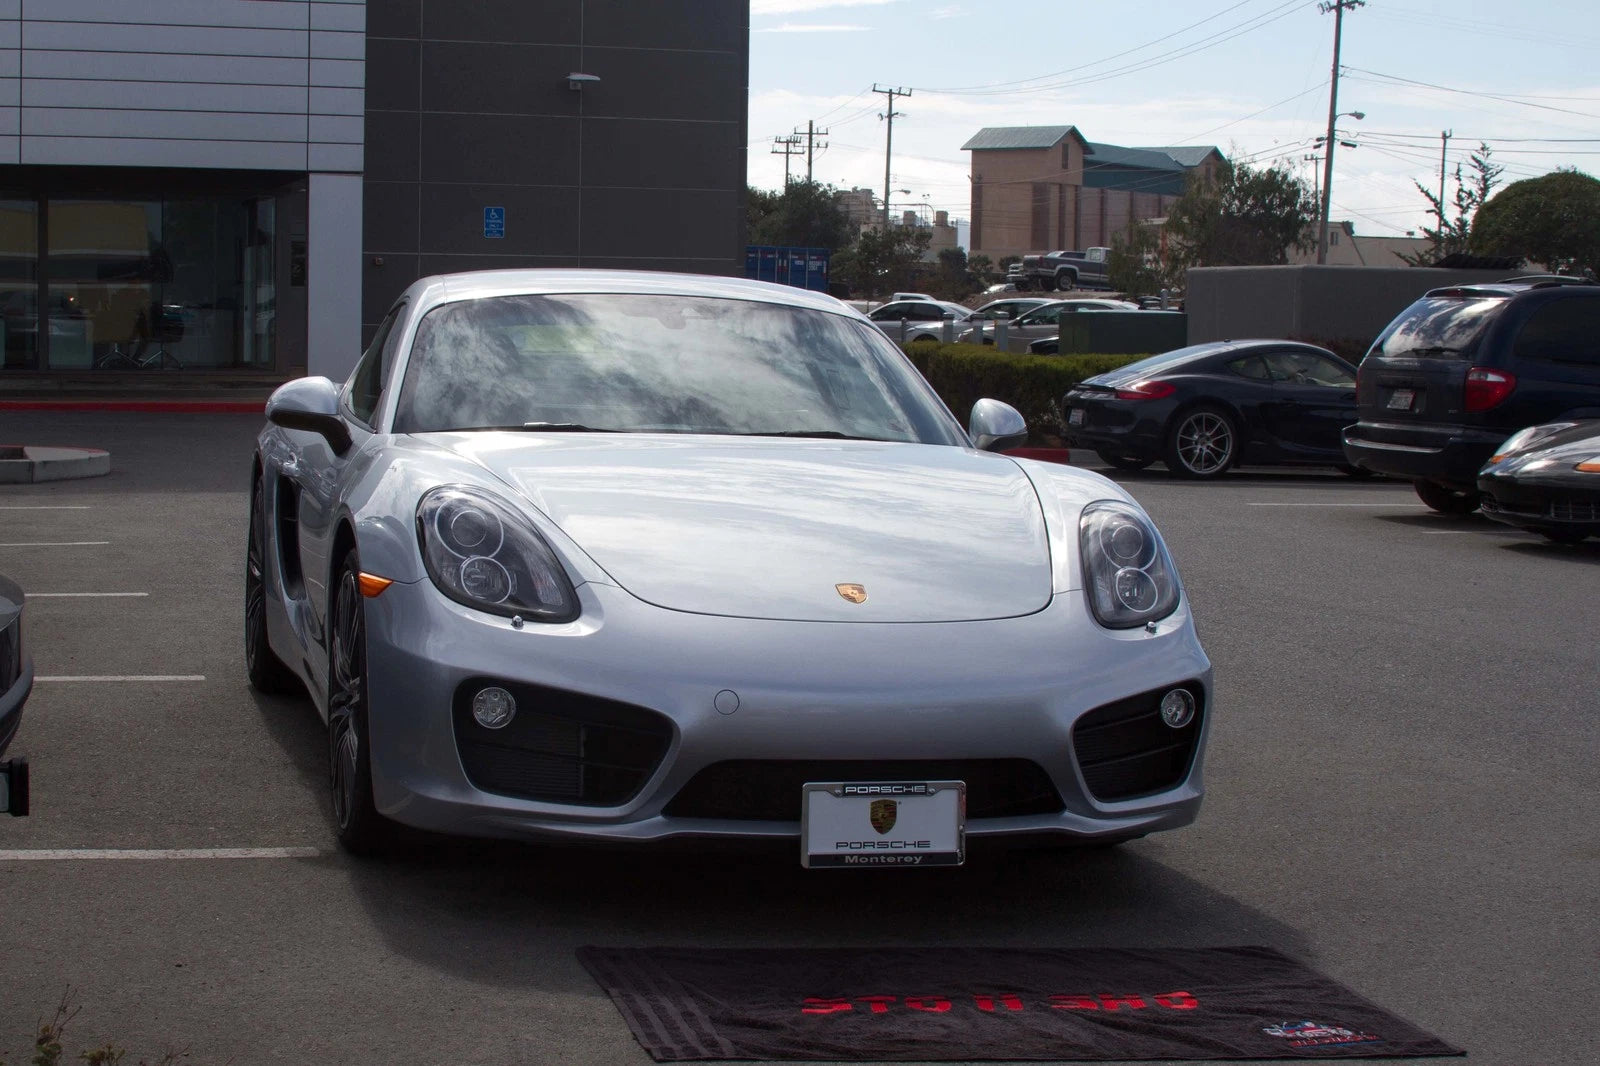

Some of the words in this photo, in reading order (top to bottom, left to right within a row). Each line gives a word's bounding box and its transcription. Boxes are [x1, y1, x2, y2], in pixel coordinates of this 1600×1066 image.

[845, 785, 926, 793] PORSCHE
[835, 840, 931, 850] PORSCHE
[845, 855, 923, 864] Monterey
